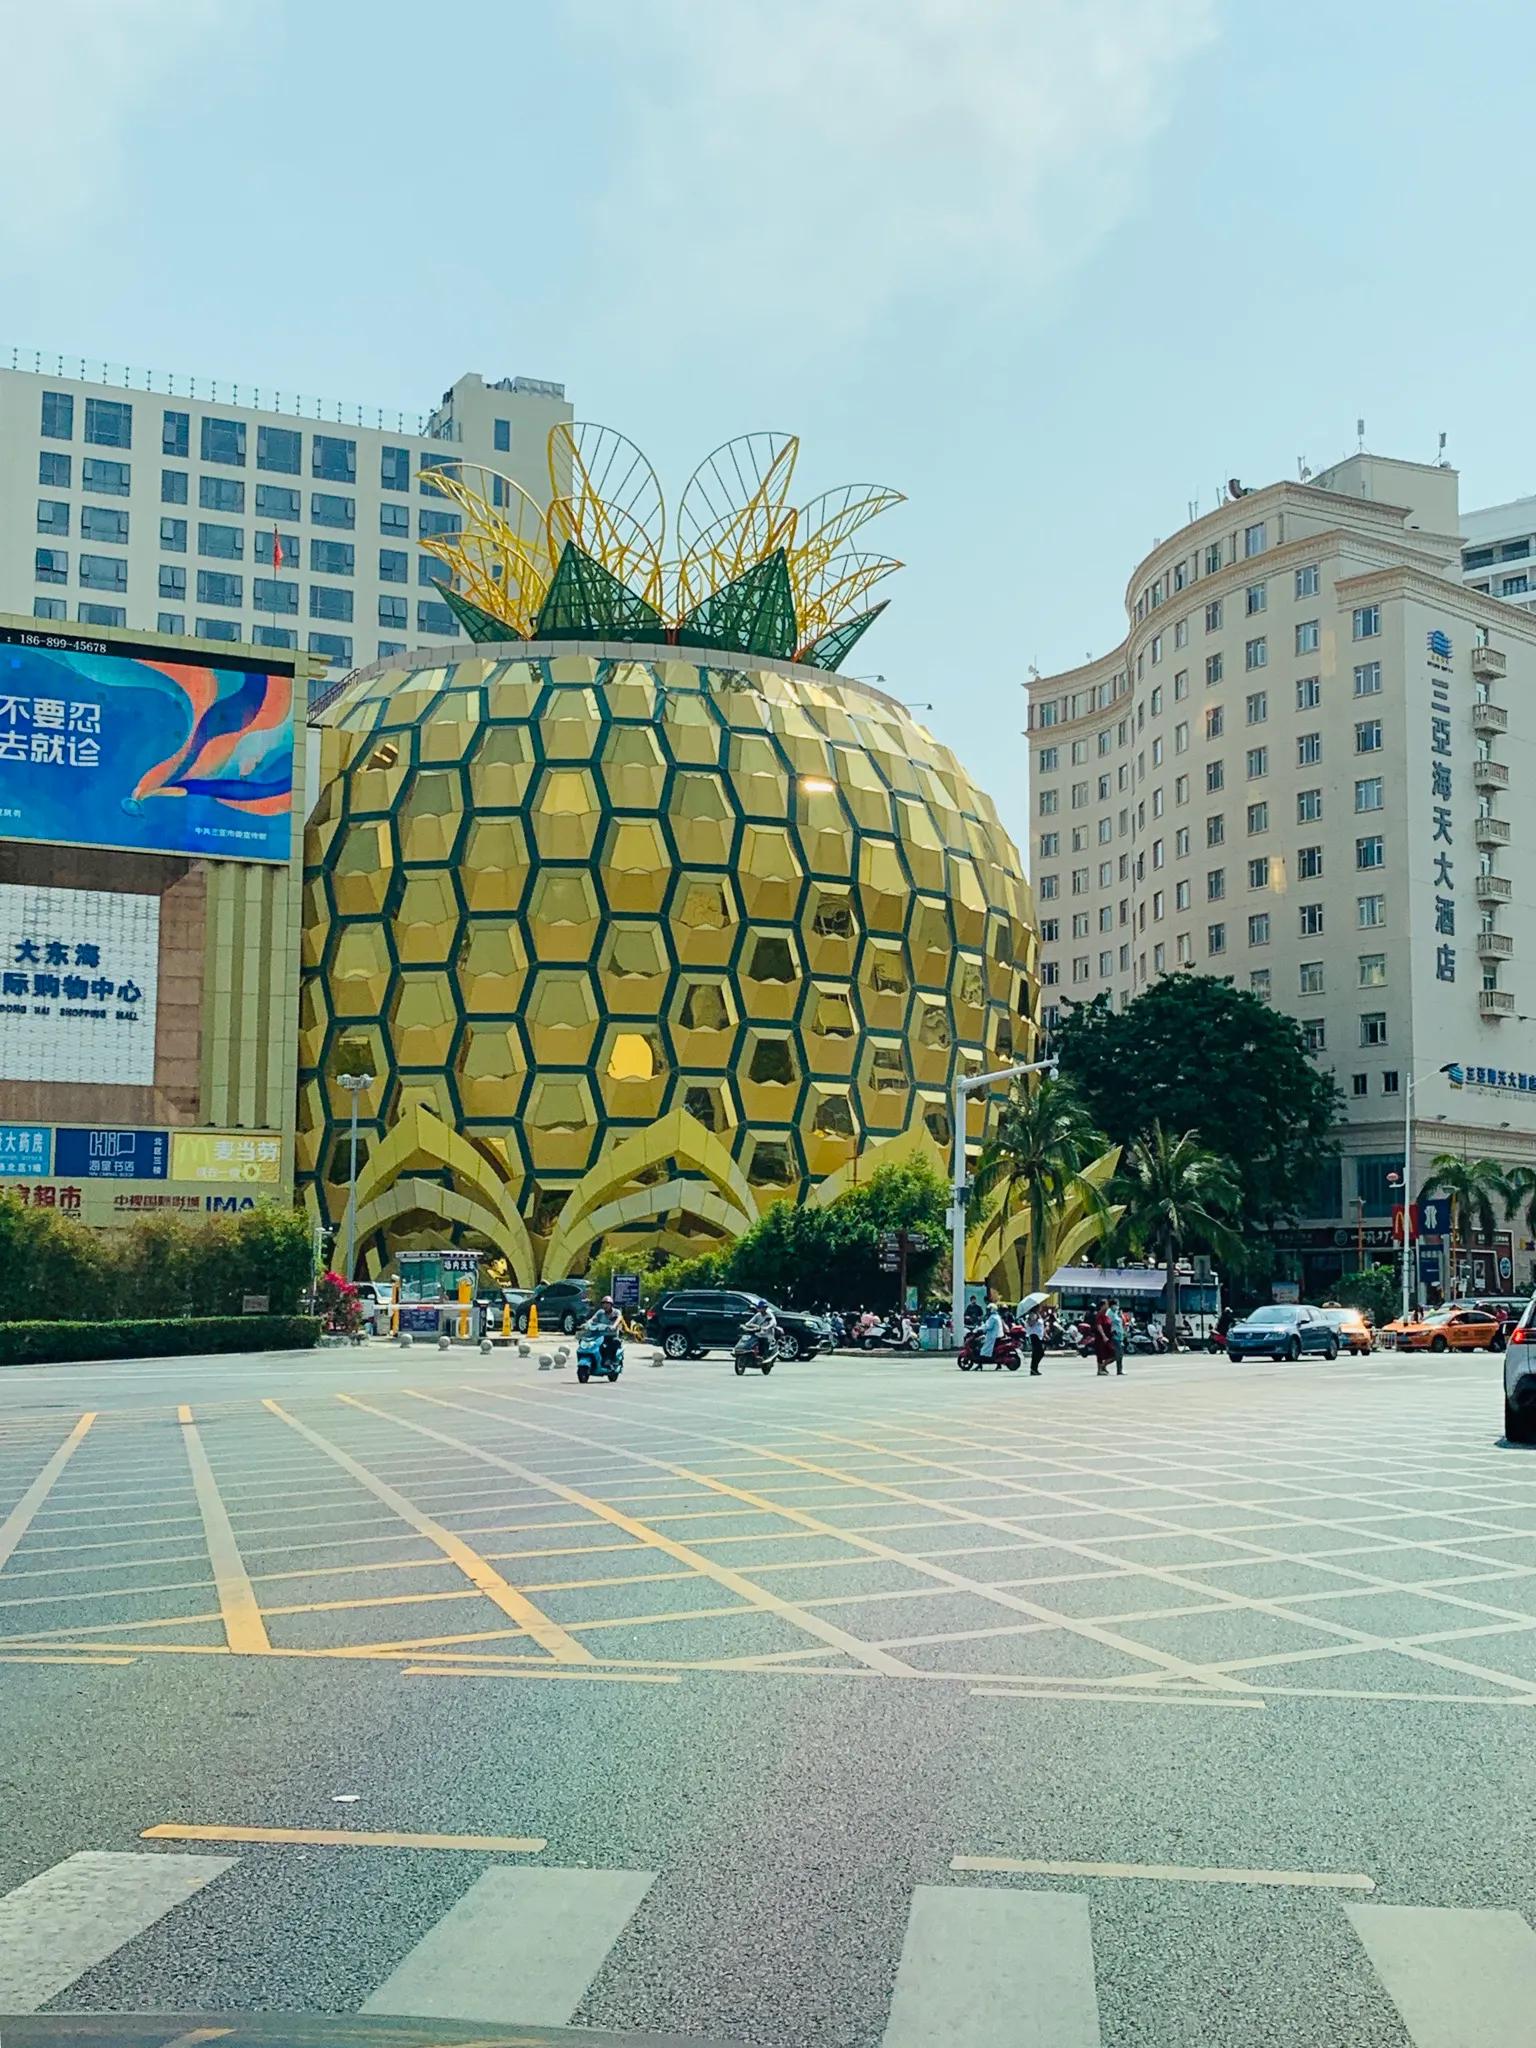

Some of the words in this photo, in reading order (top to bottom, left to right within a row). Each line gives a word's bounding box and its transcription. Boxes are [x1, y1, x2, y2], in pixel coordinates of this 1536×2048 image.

[20, 634, 107, 654] 186-899-45678
[0, 694, 101, 734] 不要忍
[0, 730, 101, 767] 去就诊
[1430, 678, 1456, 984] 三亞海天大酒店
[15, 939, 101, 968] 大东海
[0, 971, 142, 1003] 际购物中心
[34, 1006, 50, 1015] HAI
[60, 1008, 107, 1019] SHOPPING
[116, 1011, 139, 1021] MALL
[212, 1140, 278, 1162] 麦当劳
[206, 1195, 257, 1214] IMA
